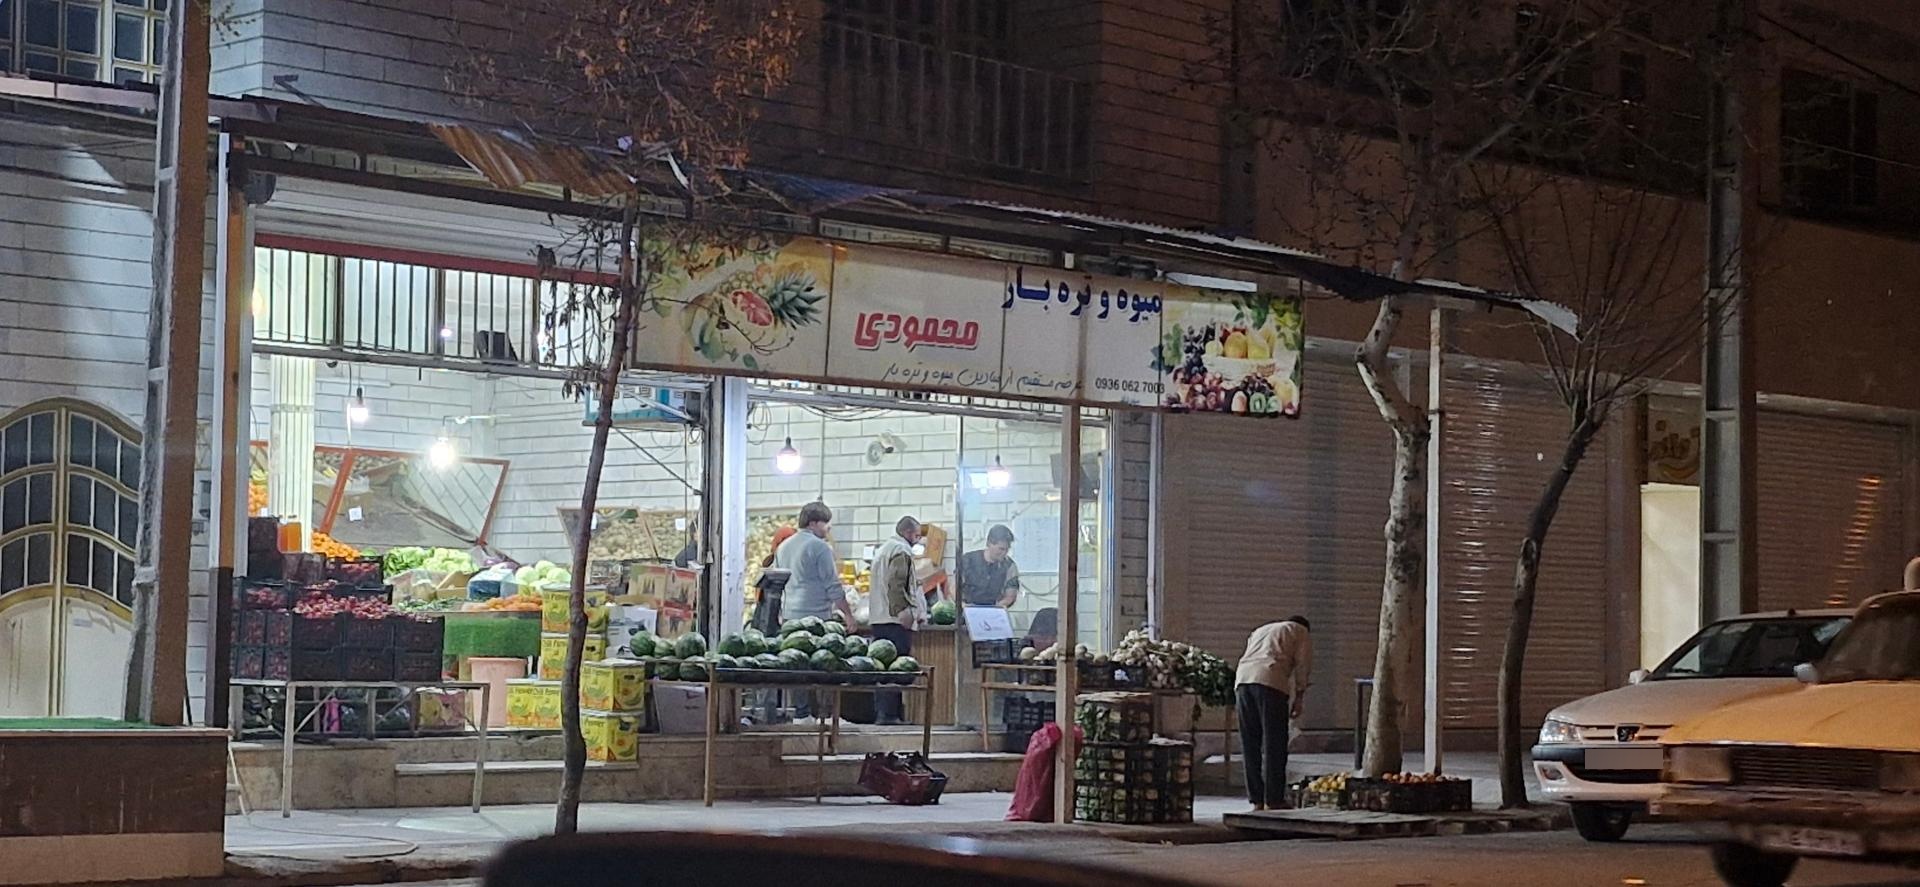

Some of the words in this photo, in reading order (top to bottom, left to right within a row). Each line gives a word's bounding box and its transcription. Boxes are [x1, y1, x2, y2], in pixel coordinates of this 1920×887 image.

[1001, 267, 1050, 312] بار
[1058, 275, 1093, 316] تره
[1097, 289, 1110, 320] و
[1117, 288, 1163, 323] میوه
[854, 312, 979, 350] محمودی
[1017, 371, 1053, 393] مستقیم
[1095, 377, 1120, 391] 0936
[1122, 379, 1140, 393] 062
[1142, 381, 1166, 394] 7003
